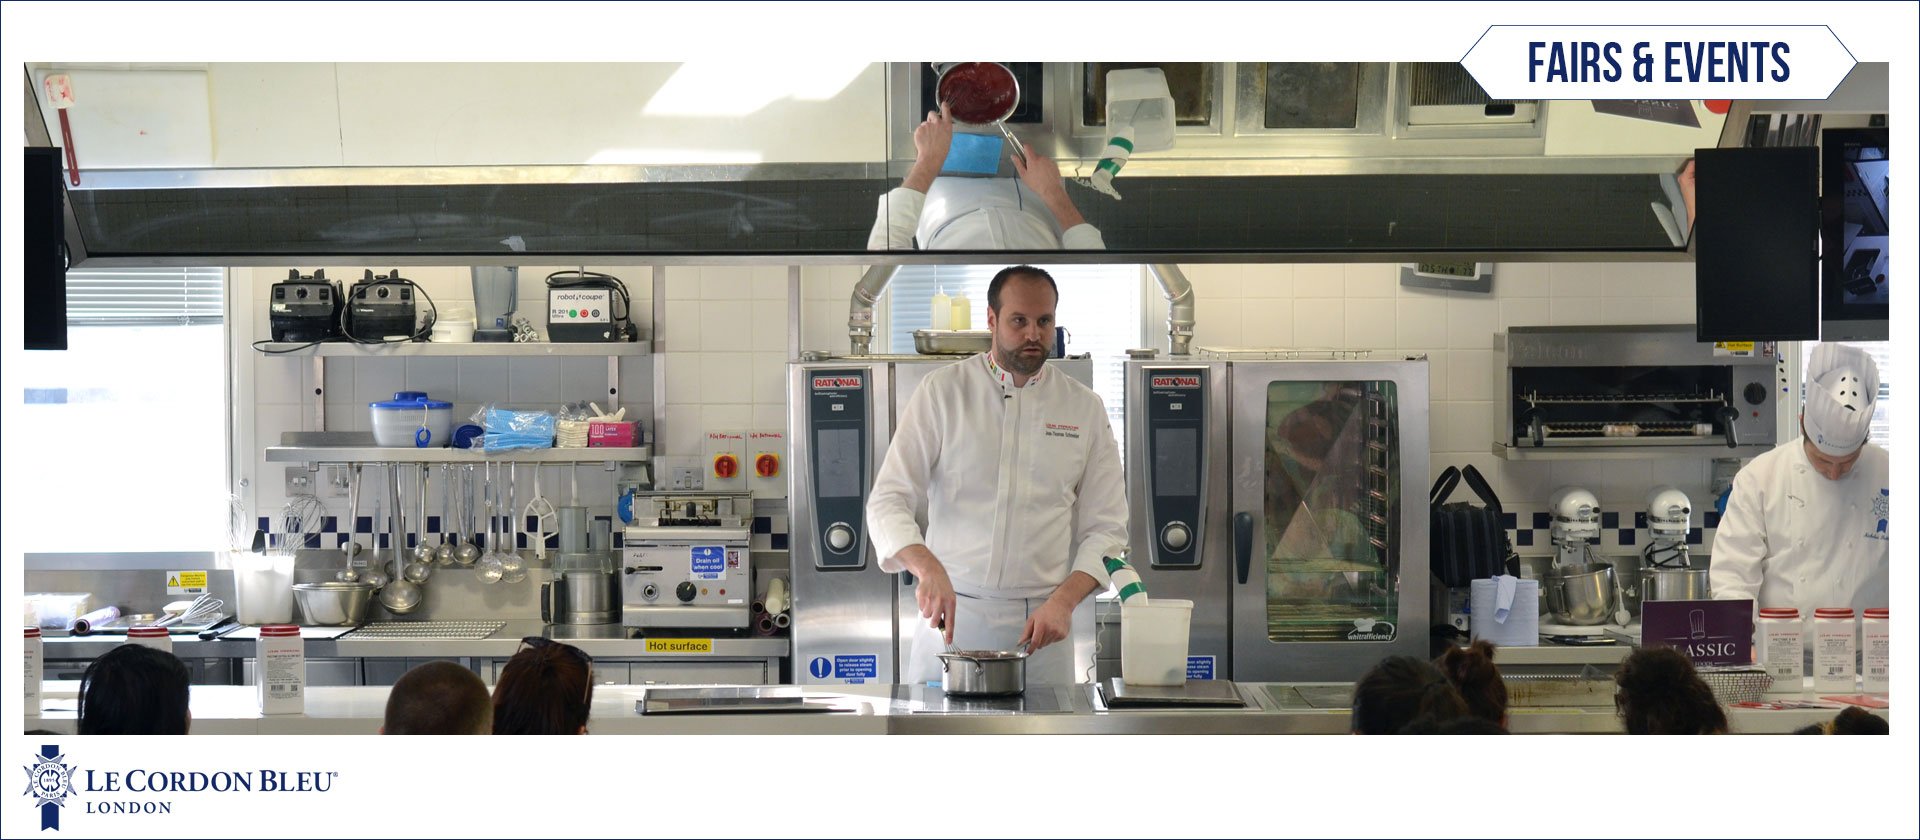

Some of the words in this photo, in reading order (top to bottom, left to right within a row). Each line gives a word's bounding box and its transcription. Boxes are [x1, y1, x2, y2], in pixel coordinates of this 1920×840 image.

[815, 378, 860, 387] RATIONAL
[1153, 378, 1198, 386] RATIONAL
[592, 424, 604, 434] 100
[650, 642, 667, 650] Hot
[670, 642, 708, 650] surface
